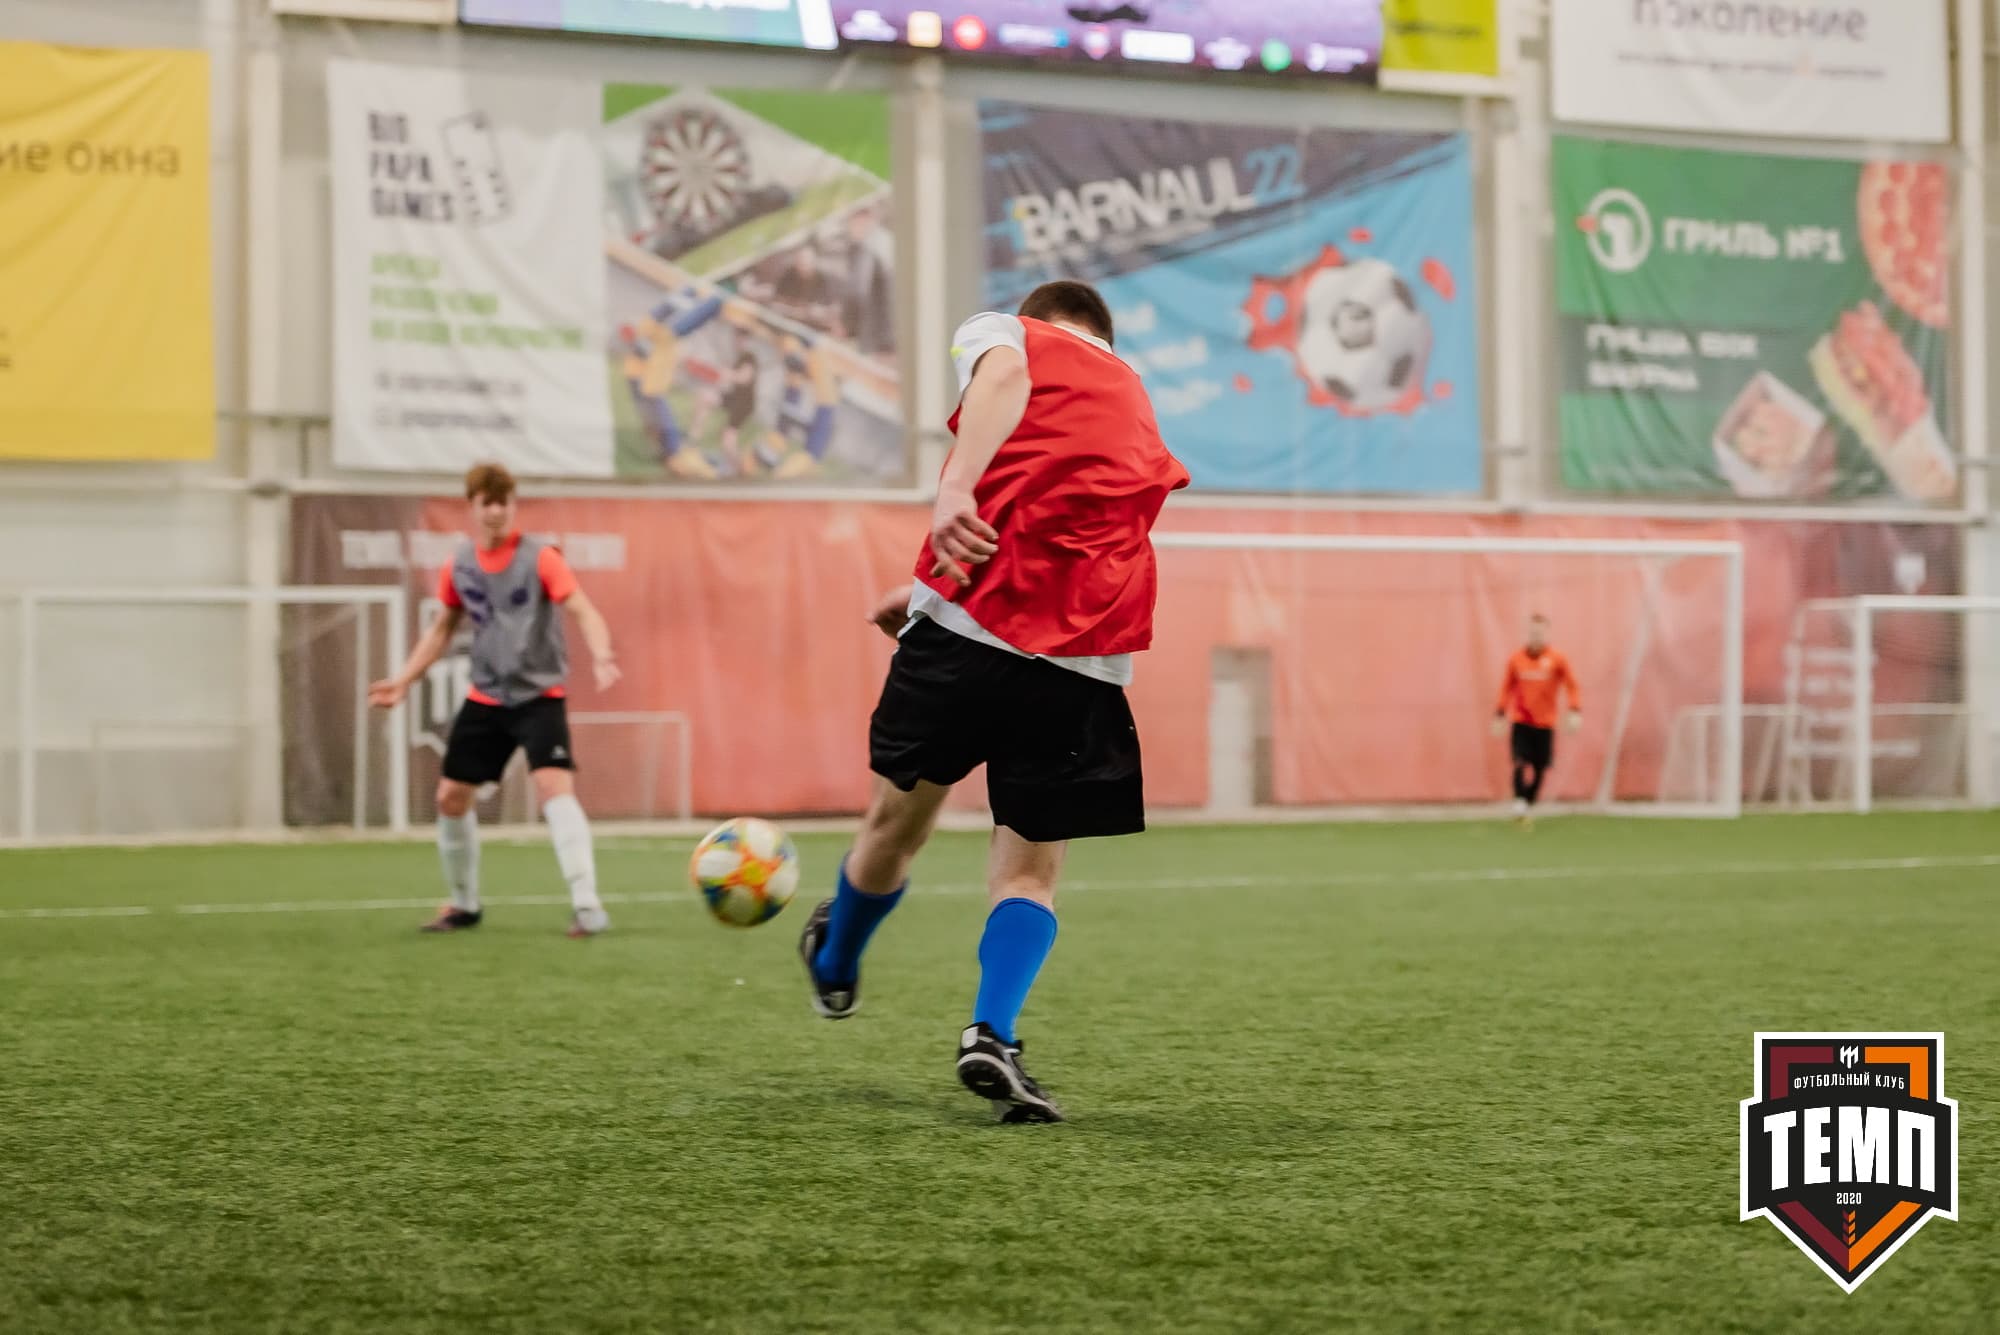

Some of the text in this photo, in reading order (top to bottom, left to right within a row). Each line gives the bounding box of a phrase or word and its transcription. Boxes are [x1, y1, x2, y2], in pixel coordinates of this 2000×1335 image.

[65, 141, 181, 178] окна
[1011, 157, 1258, 252] BARNAUL
[1663, 217, 1779, 260] ГРИЛЬ
